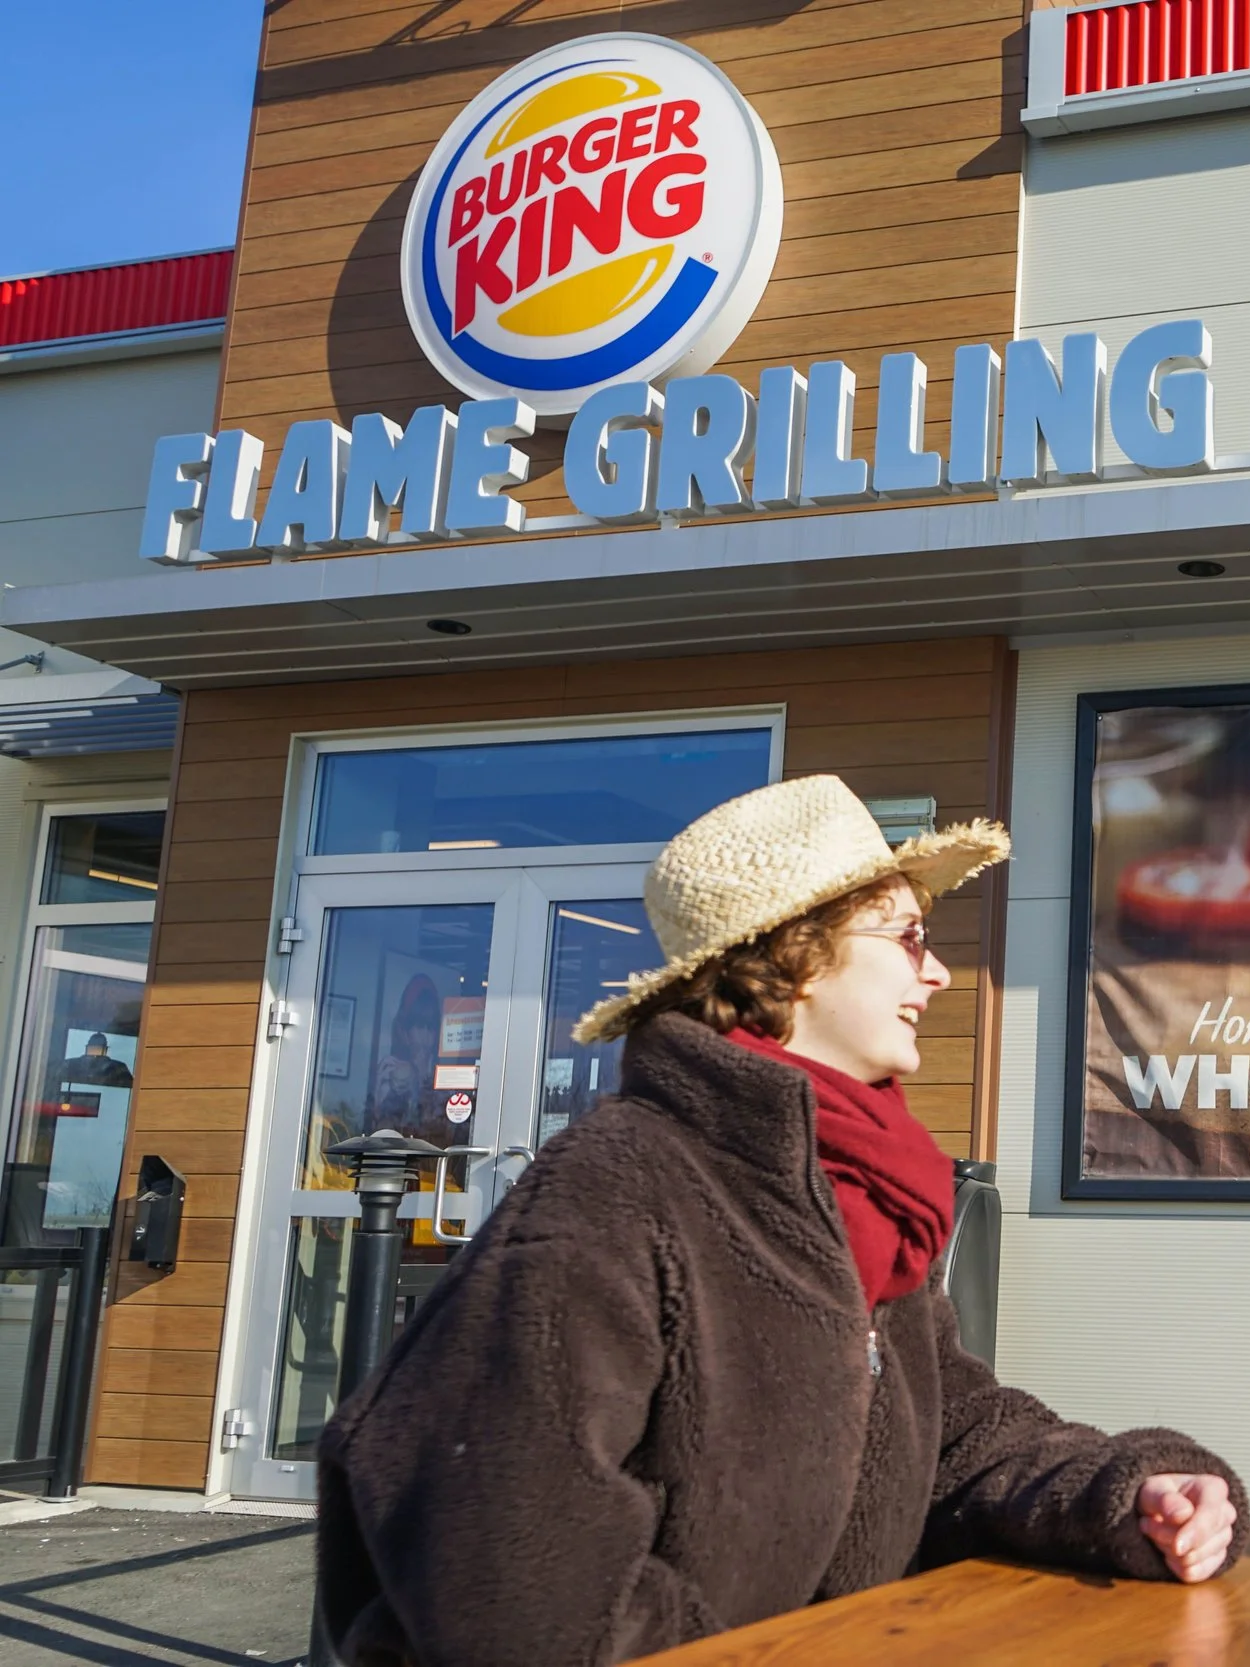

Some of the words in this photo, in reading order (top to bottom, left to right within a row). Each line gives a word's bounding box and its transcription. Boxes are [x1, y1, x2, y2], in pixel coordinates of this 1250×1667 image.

[448, 99, 701, 249] BURGER
[452, 153, 707, 337] KING
[139, 397, 534, 567] FLAME
[563, 319, 1215, 522] GRILLING
